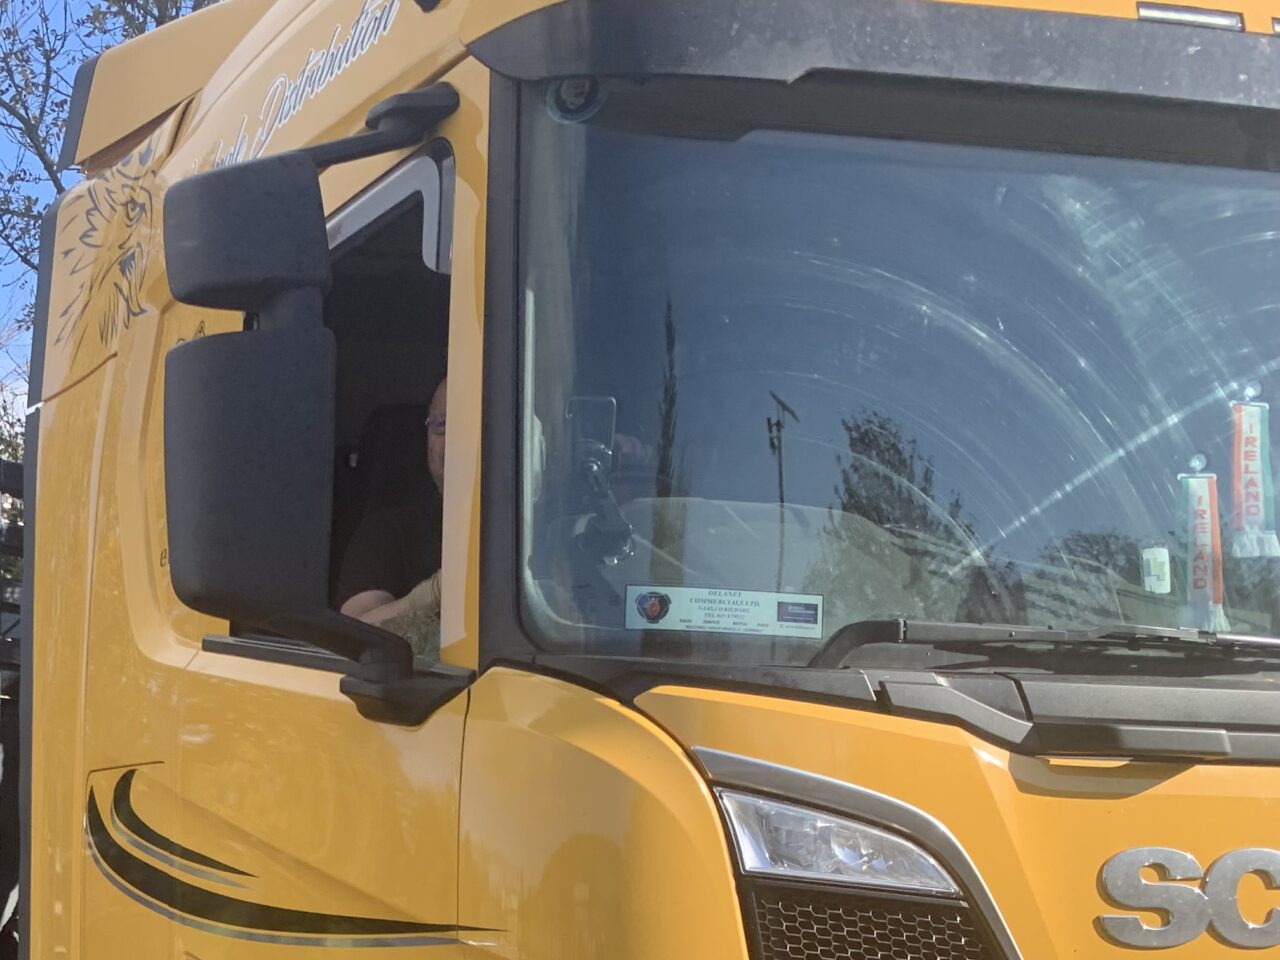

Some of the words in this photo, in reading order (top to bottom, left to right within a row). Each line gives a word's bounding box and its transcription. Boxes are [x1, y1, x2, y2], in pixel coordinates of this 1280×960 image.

[1243, 423, 1261, 518] IRELAND
[1192, 495, 1210, 591] IRELAND
[689, 598, 743, 607] COMMERCIALS
[708, 590, 742, 598] DELANEY
